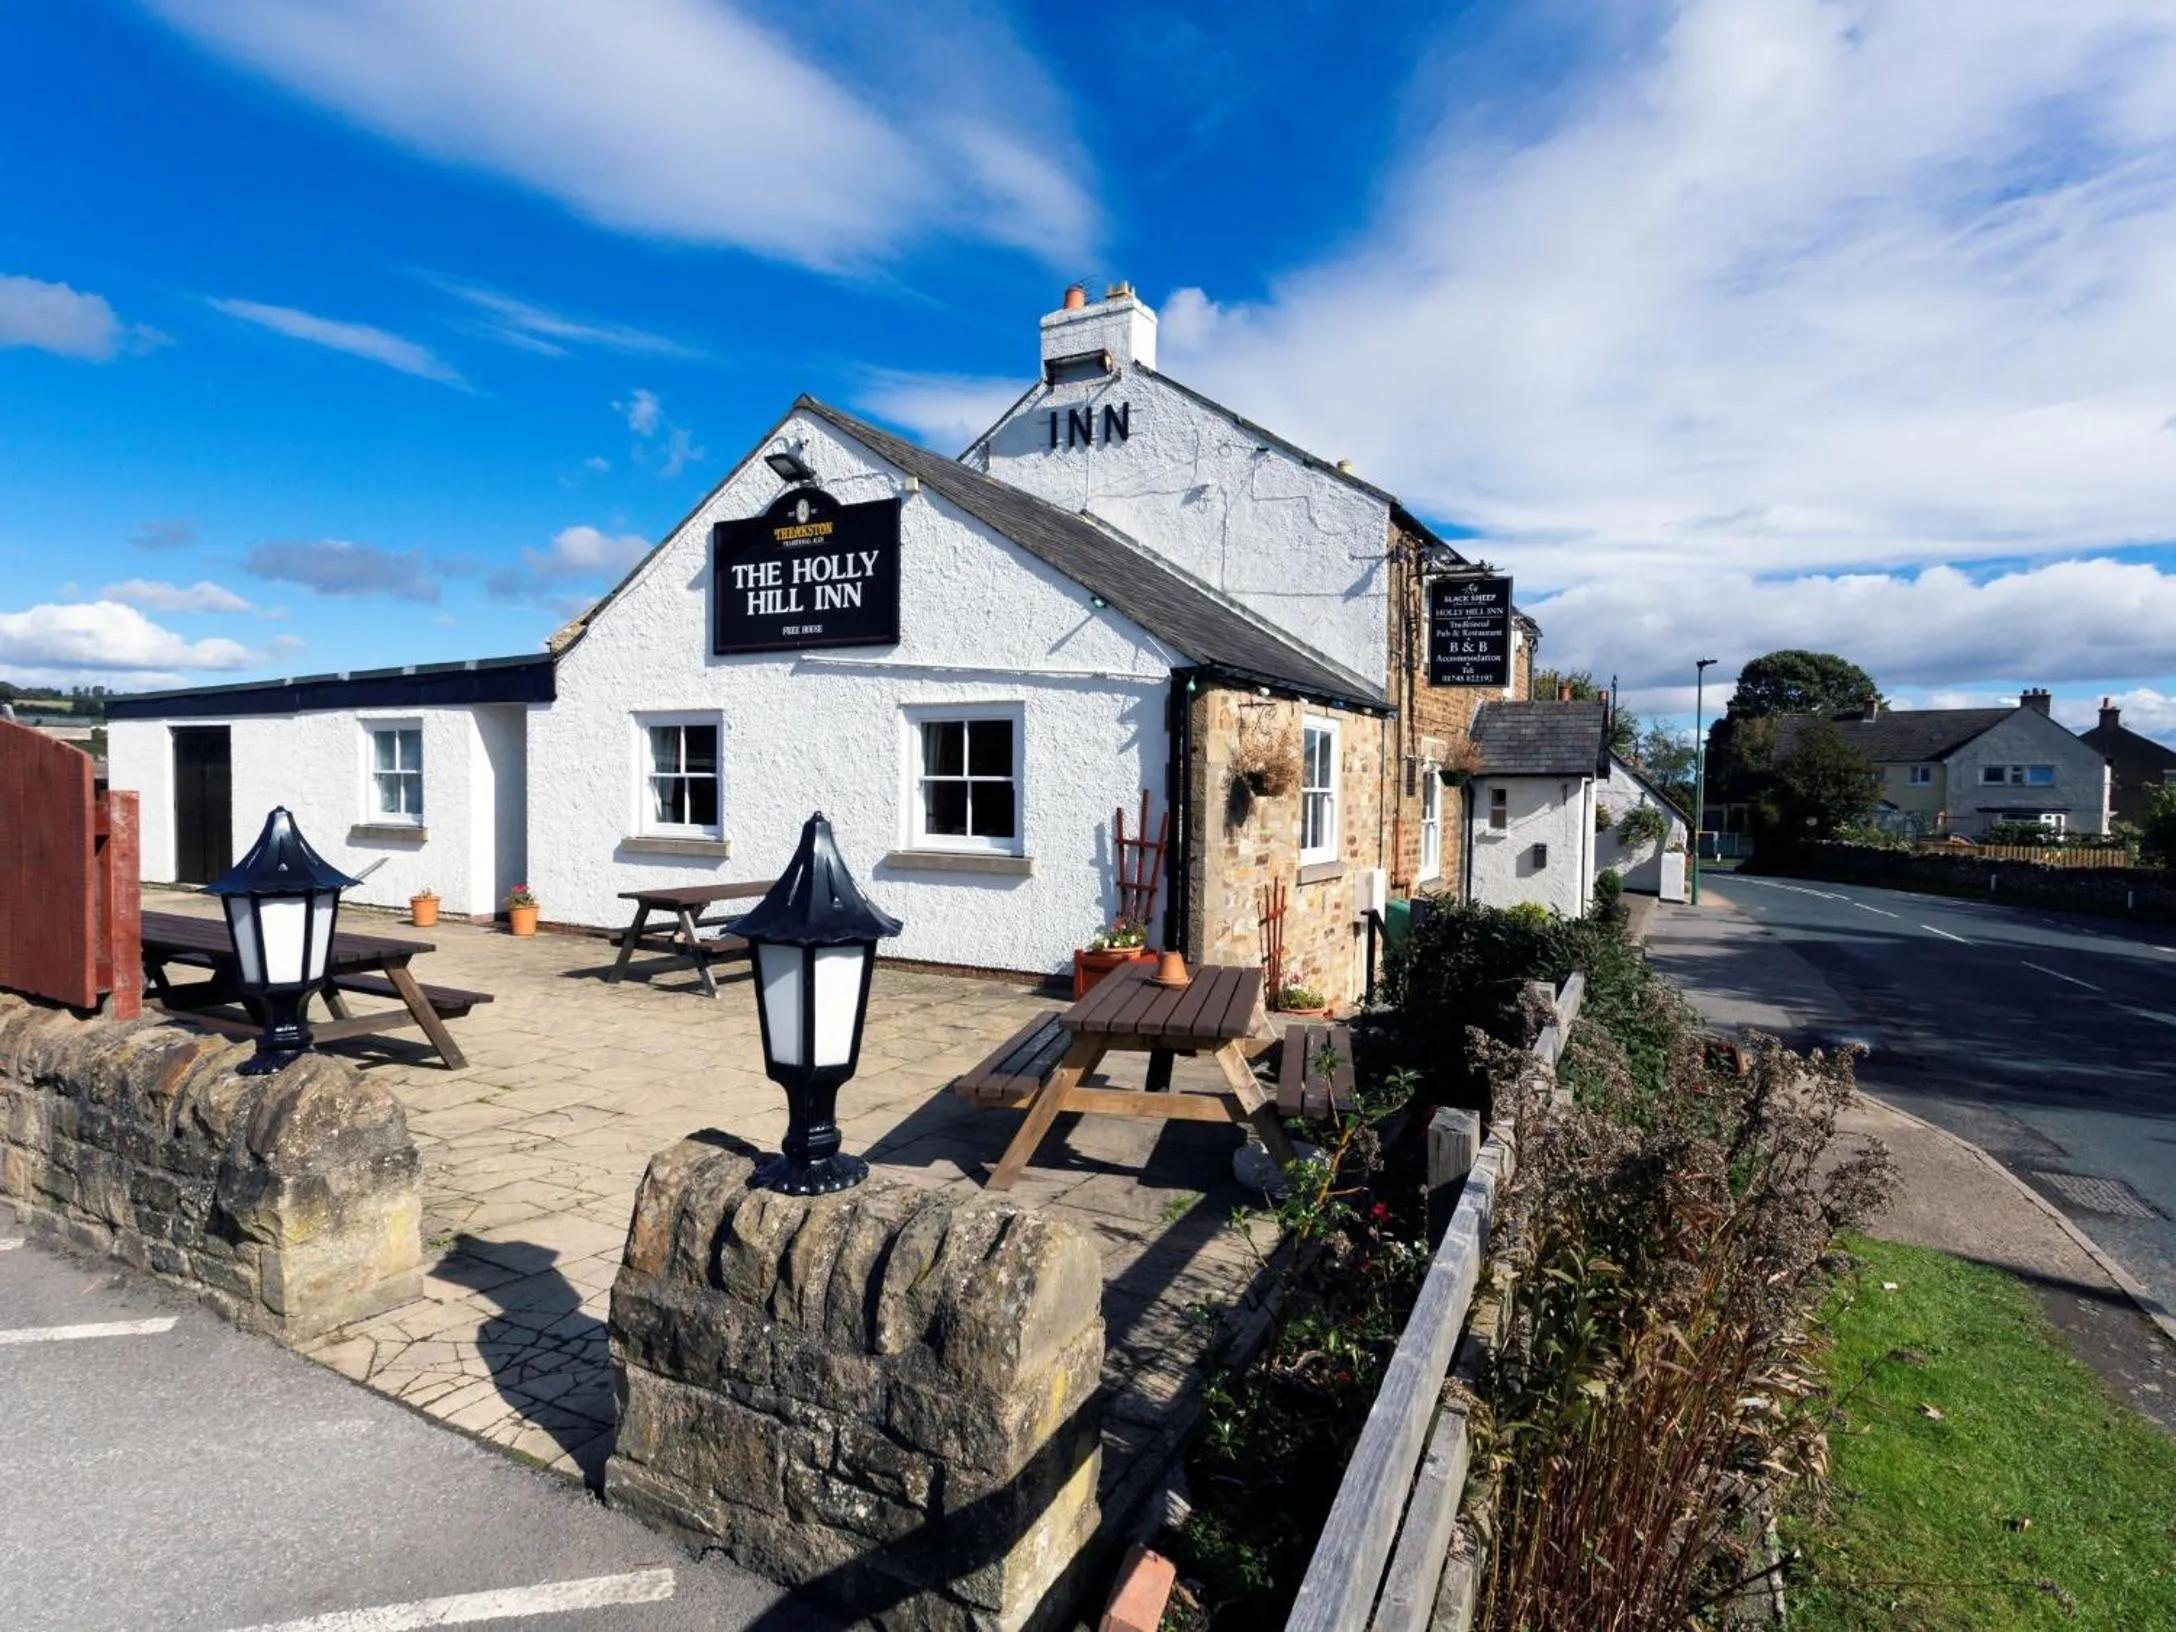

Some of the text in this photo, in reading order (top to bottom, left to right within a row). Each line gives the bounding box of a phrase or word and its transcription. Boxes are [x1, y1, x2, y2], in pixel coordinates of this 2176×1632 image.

[1051, 402, 1129, 449] INN
[732, 550, 879, 589] THE HOLLY
[747, 582, 863, 616] HILL INN
[1444, 595, 1469, 603] BLACK
[1436, 608, 1462, 616] HOLLY
[1465, 608, 1484, 616] HILL
[1462, 629, 1502, 637] Restaurant
[1450, 641, 1488, 653] B & B
[1436, 654, 1501, 662] Accommodation
